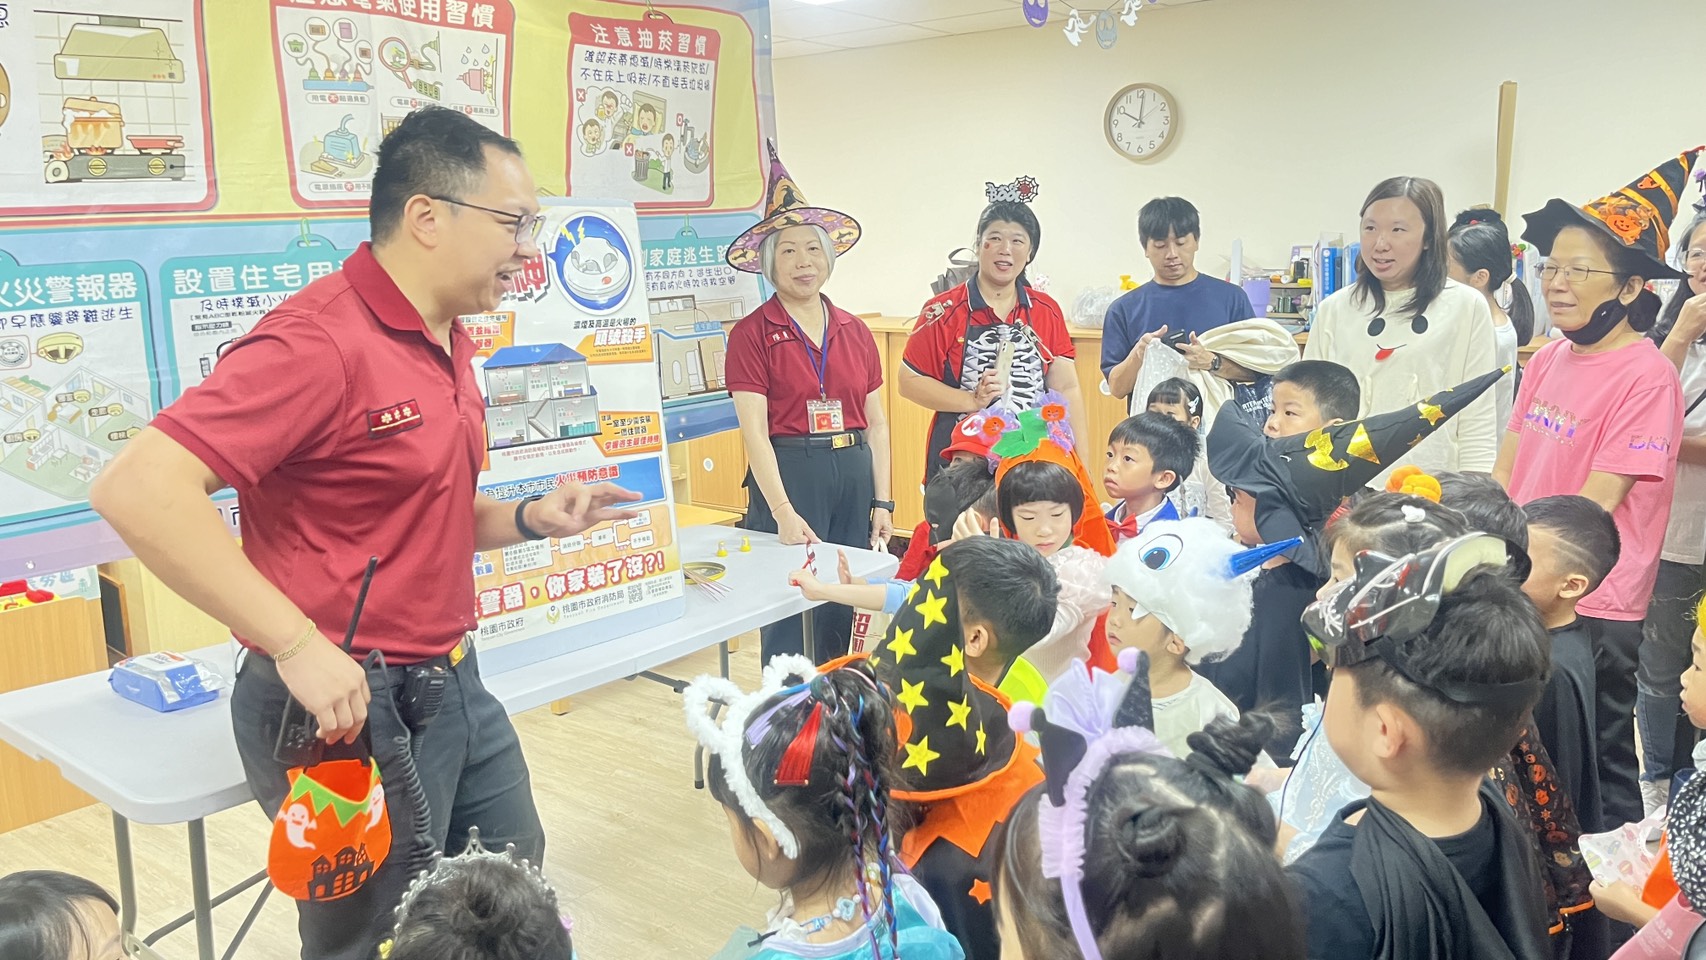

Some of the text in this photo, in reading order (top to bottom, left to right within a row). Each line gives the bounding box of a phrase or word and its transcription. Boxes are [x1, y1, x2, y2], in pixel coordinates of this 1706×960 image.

[590, 23, 706, 56] 注意抽菸習慣
[173, 260, 345, 295] 設置住宅用
[574, 317, 637, 330] 濃煙及高溫是火場的
[595, 328, 646, 347] 頭號殺手
[475, 551, 664, 619] 警器，你家裝了沒?!
[562, 590, 625, 614] 桃園市政府消防局
[480, 617, 524, 636] 桃園市政府
